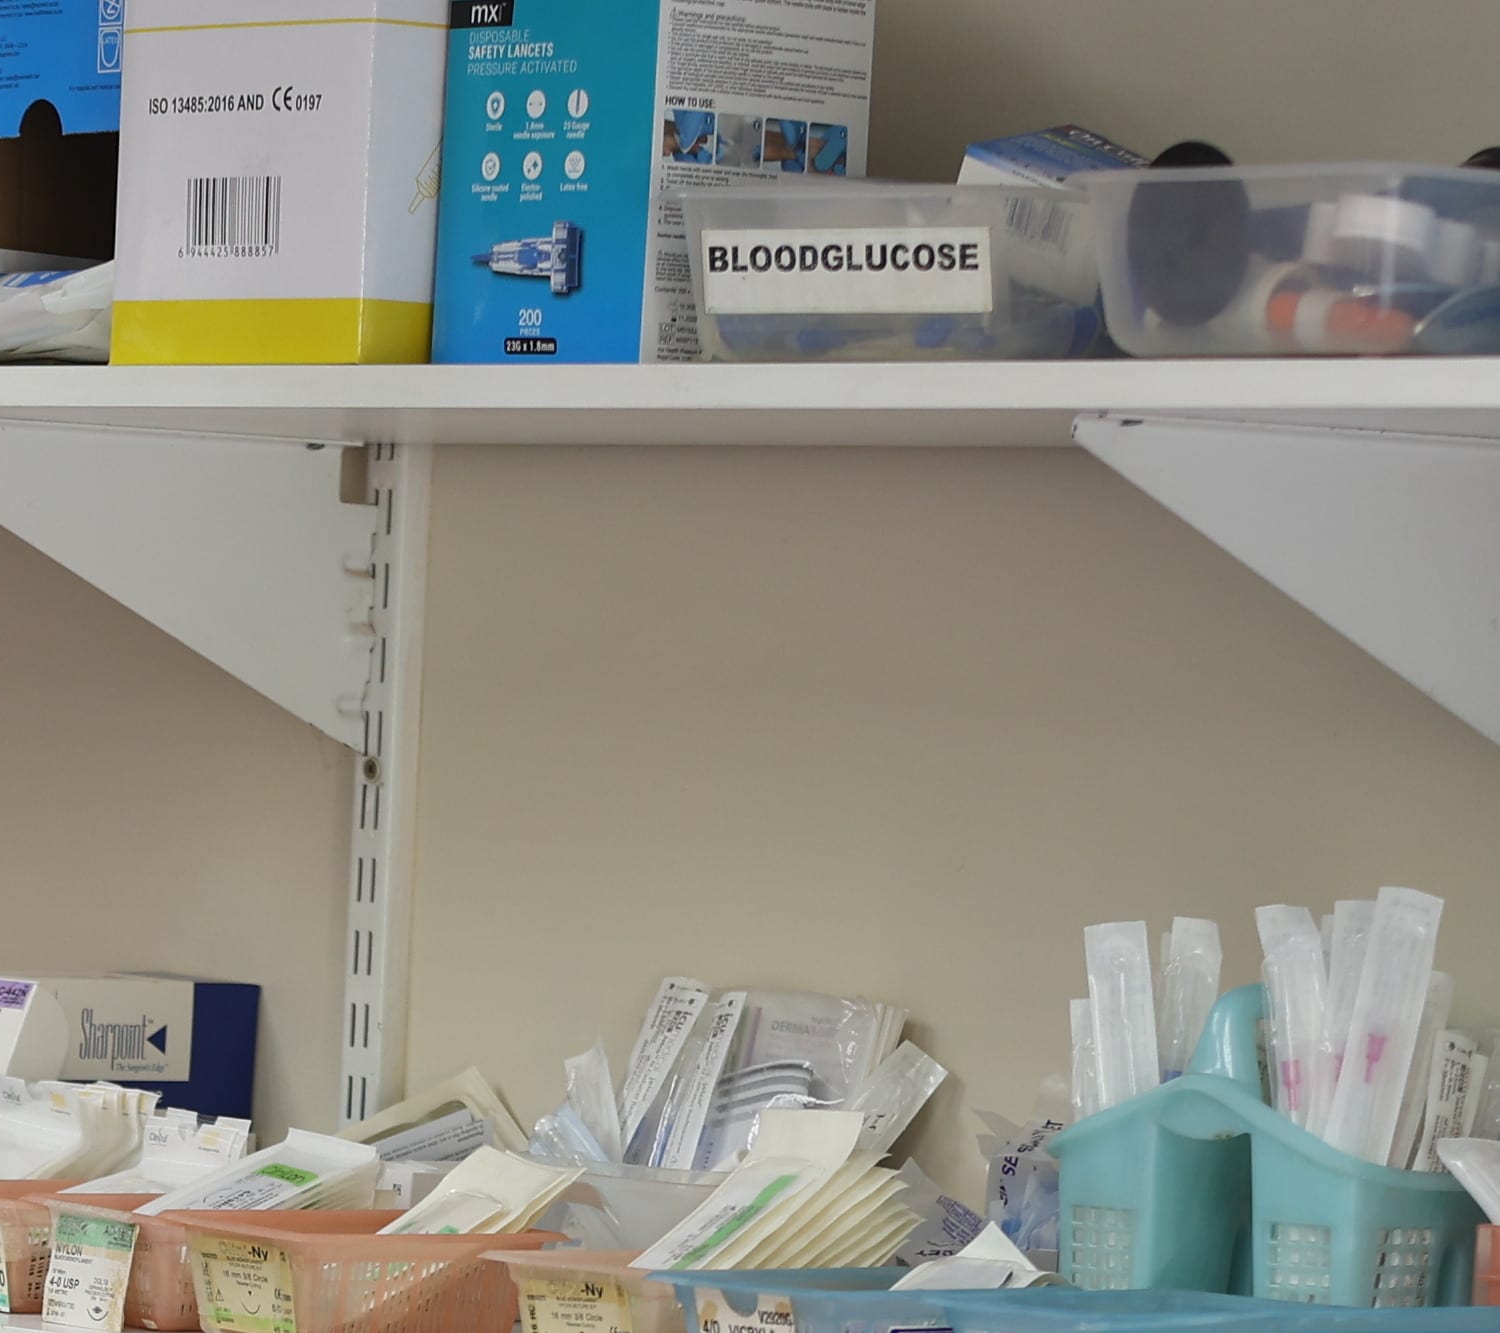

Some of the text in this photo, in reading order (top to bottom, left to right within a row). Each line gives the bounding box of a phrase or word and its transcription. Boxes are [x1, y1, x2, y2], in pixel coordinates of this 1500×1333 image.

[469, 30, 530, 44] DISPOSABLE
[468, 43, 553, 60] SAFETY LANCETS
[467, 60, 577, 75] PRESSURE ACTIVATED
[149, 98, 168, 114] ISO
[172, 95, 234, 113] 13485:2016
[237, 94, 264, 111] AND
[296, 94, 322, 111] 0197
[665, 96, 685, 106] HOW
[687, 98, 697, 107] TO
[708, 244, 979, 272] BLOODGLUCOSE
[519, 308, 541, 326] 200
[79, 1008, 147, 1072] Sharpoint
[55, 1243, 83, 1256] NYLON
[62, 1277, 80, 1289] USP
